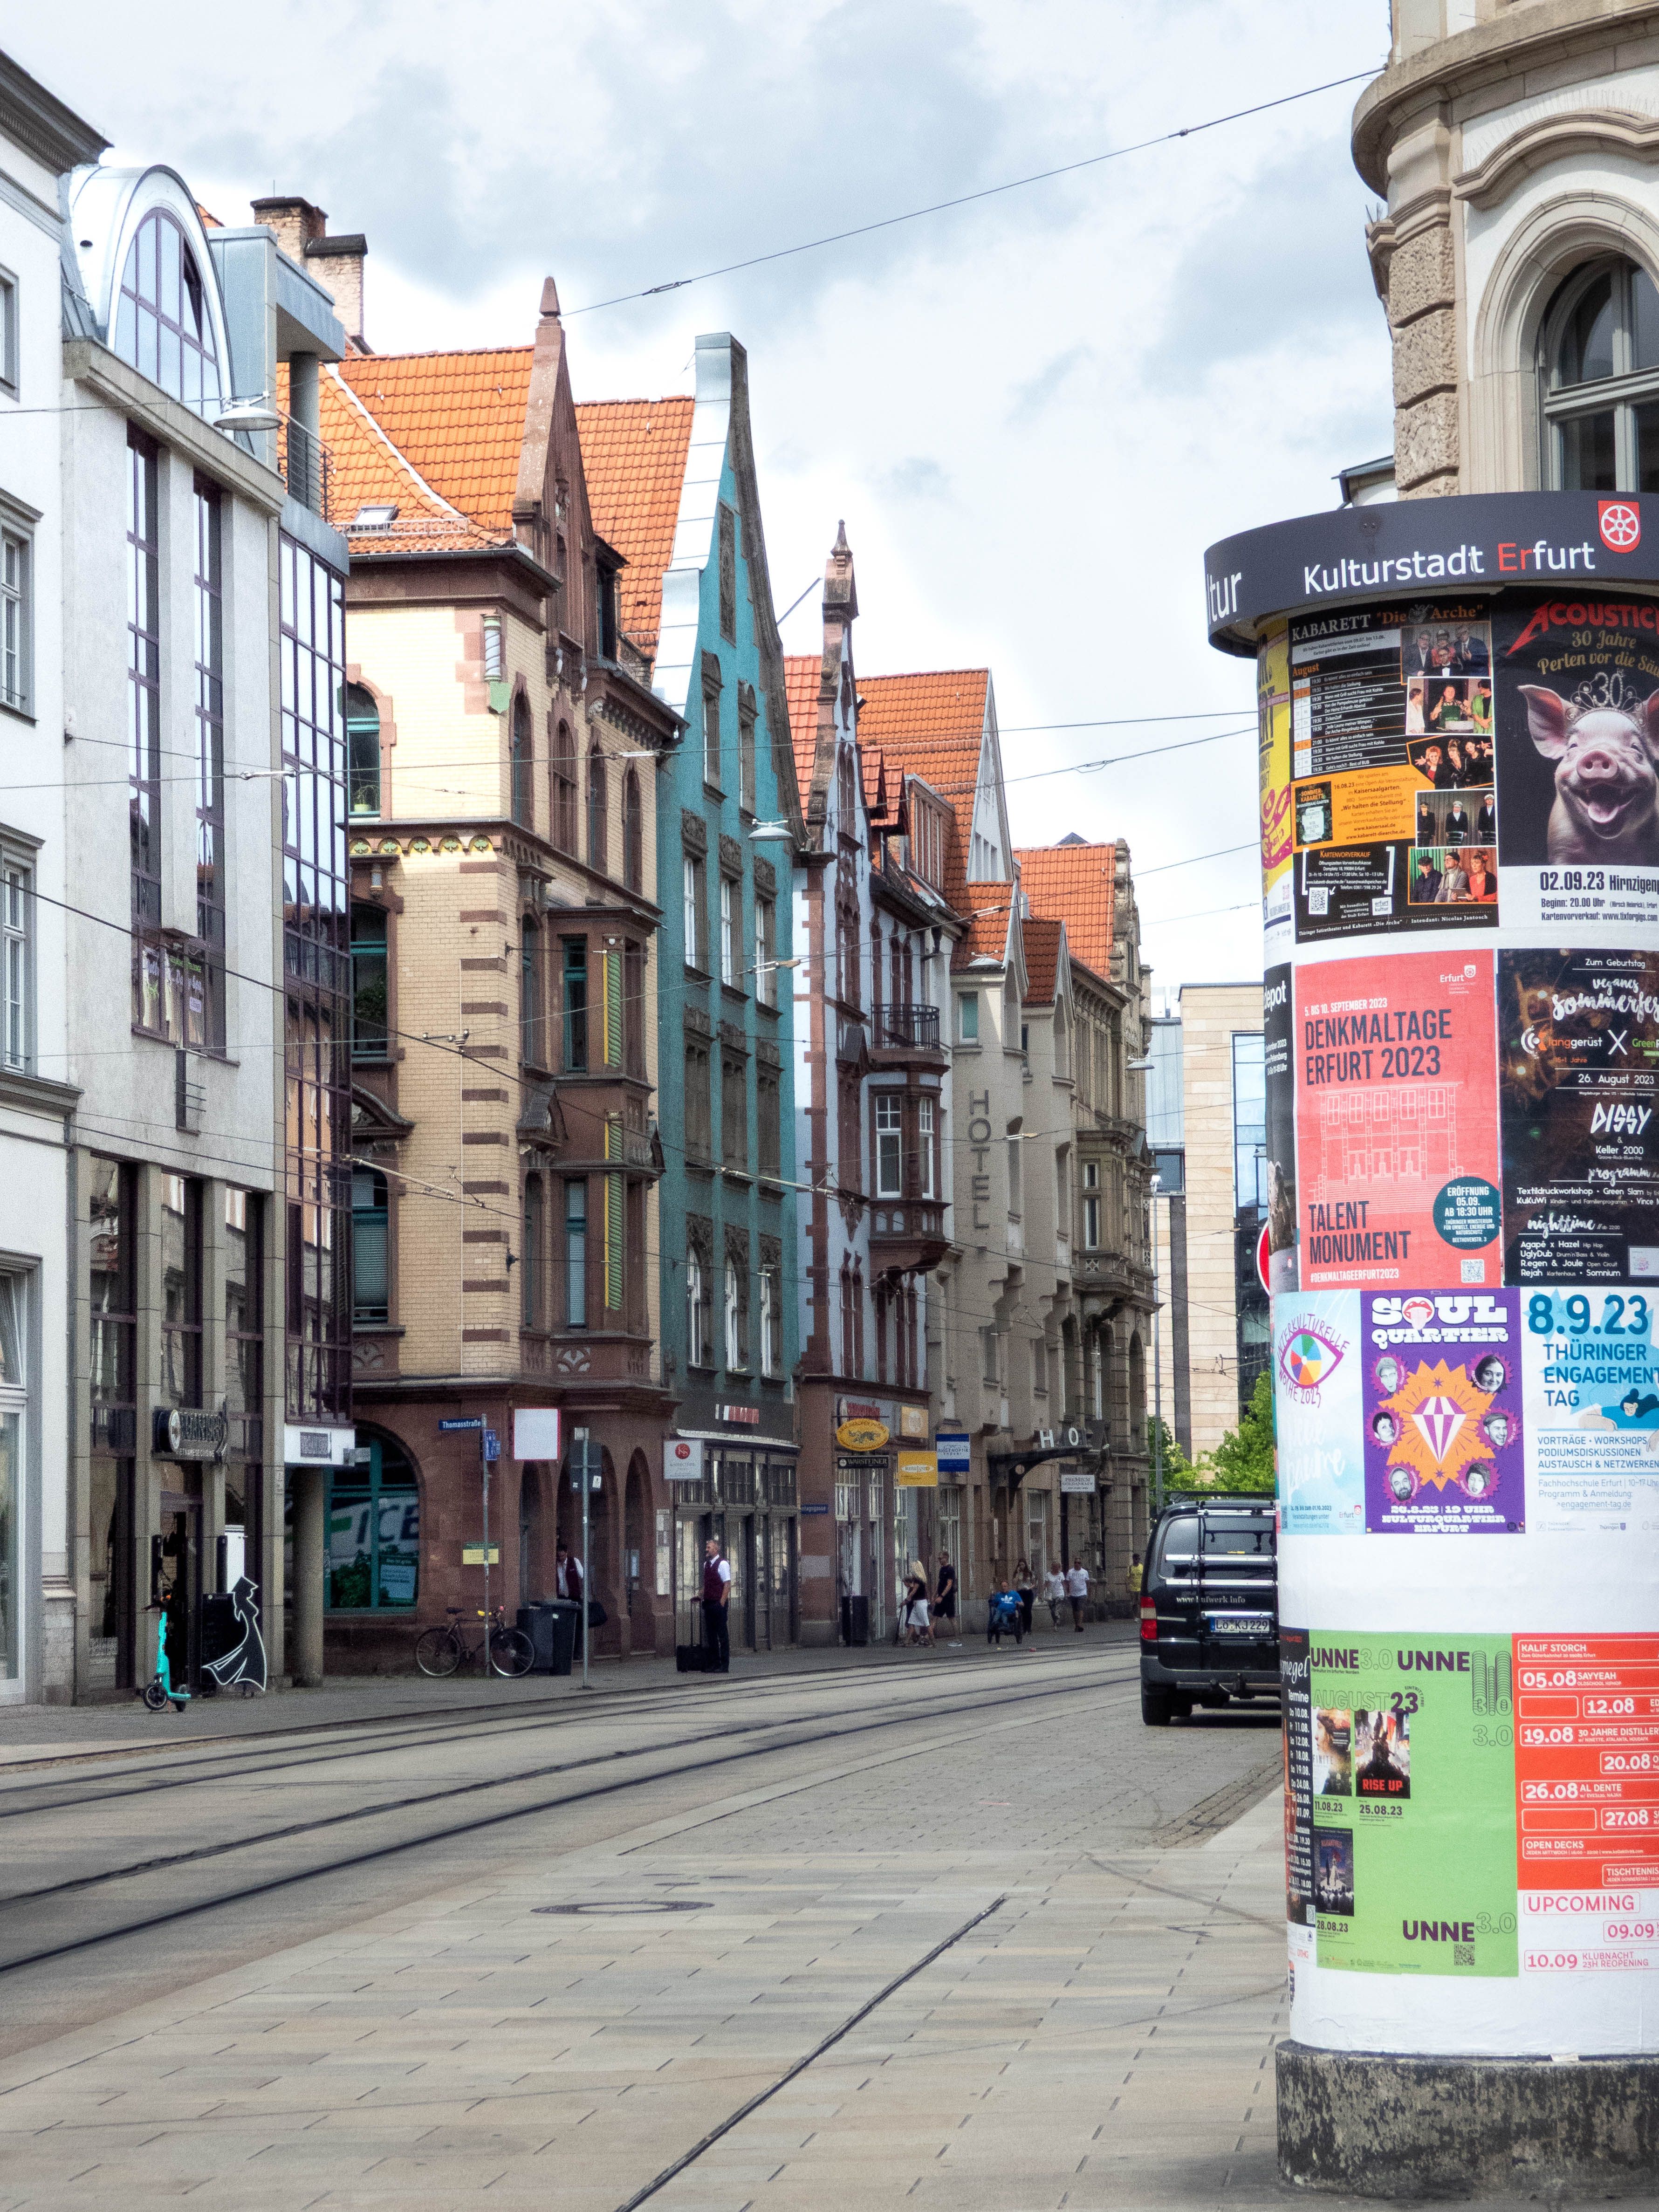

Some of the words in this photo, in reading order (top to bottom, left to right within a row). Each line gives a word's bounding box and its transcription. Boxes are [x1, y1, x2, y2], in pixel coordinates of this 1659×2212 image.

[1304, 545, 1484, 594] Kulturstadt
[1498, 540, 1595, 572] Erfurt
[1292, 614, 1371, 641] KABARETT
[1506, 600, 1659, 656] ACOUSTIC
[1572, 630, 1591, 647] 30
[1597, 630, 1636, 648] Jahre
[1293, 662, 1319, 678] August
[1538, 652, 1585, 675] Perlen
[1590, 653, 1611, 664] vor
[1615, 652, 1635, 667] die
[1354, 785, 1401, 794] Kaisersaalgarten.
[1540, 871, 1604, 890] 02.09.23
[1542, 898, 1568, 908] Beginn:
[1570, 897, 1590, 907] 20.00
[1593, 898, 1605, 907] Uhr
[1542, 912, 1600, 920] Kartenvorverkauf:
[1602, 912, 1658, 922] www.tixforgigs.com
[1607, 959, 1645, 969] Geburtstag
[1440, 973, 1464, 982] Erfurt
[1593, 978, 1638, 996] veganes
[1305, 1006, 1310, 1016] 5.
[1311, 1005, 1319, 1015] BIS
[1321, 1003, 1329, 1014] 10.
[1330, 1000, 1368, 1013] SEPTEMBER
[1369, 998, 1387, 1009] 2023
[1305, 1009, 1452, 1050] DENKMALTAGE
[1548, 1037, 1603, 1049] langgerüst
[1306, 1049, 1373, 1086] ERFURT
[1381, 1045, 1440, 1078] 2023
[1578, 1074, 1592, 1083] 26.
[1598, 1074, 1629, 1085] August
[1634, 1075, 1654, 1084] 2023
[1590, 1102, 1652, 1135] DISSY
[1596, 1146, 1619, 1154] Keller
[1623, 1146, 1644, 1155] 2000
[968, 1089, 991, 1229] HOTEL
[1447, 1185, 1489, 1196] ERÖFFNUNG
[1517, 1187, 1593, 1196] Textildruckworkshop
[1456, 1197, 1480, 1206] 05.09.
[1308, 1201, 1369, 1232] TALENT
[1445, 1207, 1454, 1216] AB
[1456, 1207, 1476, 1216] 18:30
[1478, 1206, 1493, 1216] UHR
[1528, 1212, 1596, 1239] nighttime
[1309, 1231, 1411, 1265] MONUMENT
[1520, 1250, 1552, 1259] UglyDub
[1521, 1260, 1547, 1268] R.egen
[1310, 1268, 1399, 1283] #DENKMALTAGEERFURT2023
[1521, 1269, 1542, 1278] Rejah
[1529, 1294, 1648, 1335] 8.9.23
[1371, 1327, 1508, 1350] QUARTIER
[1542, 1338, 1646, 1361] THÜRINGER
[1301, 1384, 1321, 1408] 2023
[1543, 1390, 1580, 1406] TAG
[442, 1420, 481, 1429] Thomasstraße
[1538, 1434, 1586, 1445] VORTRÄGE
[1594, 1436, 1647, 1445] WORKSHOPS
[1538, 1448, 1640, 1457] PODIUMSDISKUSSIONEN
[1538, 1490, 1580, 1500] Programm
[1590, 1490, 1632, 1499] Anmeldung:
[1561, 1500, 1631, 1510] engagement-tag.de
[1236, 1619, 1248, 1630] KJ
[1250, 1621, 1268, 1630] 229
[1310, 1647, 1359, 1669] UNNE
[1360, 1648, 1393, 1670] 3.0
[1398, 1650, 1470, 1672] UNNE
[1522, 1670, 1577, 1688] 05.08
[1312, 1689, 1391, 1712] AUGUST
[1390, 1692, 1419, 1713] 23
[1587, 1698, 1635, 1714] 12.08
[1473, 1725, 1513, 1746] 3.0
[1524, 1726, 1573, 1744] 19.08
[1604, 1753, 1650, 1770] 20.08
[1363, 1779, 1385, 1790] RISE
[1389, 1780, 1403, 1791] UP
[1525, 1783, 1578, 1799] 26.08
[1594, 1783, 1622, 1792] DENTE
[1314, 1800, 1343, 1813] 11.08.23
[1359, 1804, 1403, 1816] 25.08.23
[1605, 1809, 1648, 1826] 27.08
[1606, 1867, 1659, 1876] TISCHTENNIS
[1528, 1894, 1634, 1912] UPCOMING
[1316, 1919, 1349, 1932] 28.08.23
[1402, 1919, 1474, 1942] UNNE
[1475, 1911, 1516, 1934] 3.0
[1607, 1924, 1654, 1939] 09.09
[1528, 1953, 1577, 1969] 10.09
[1582, 1951, 1634, 1959] KLUBNACHT
[1601, 1959, 1649, 1967] REOPENING
